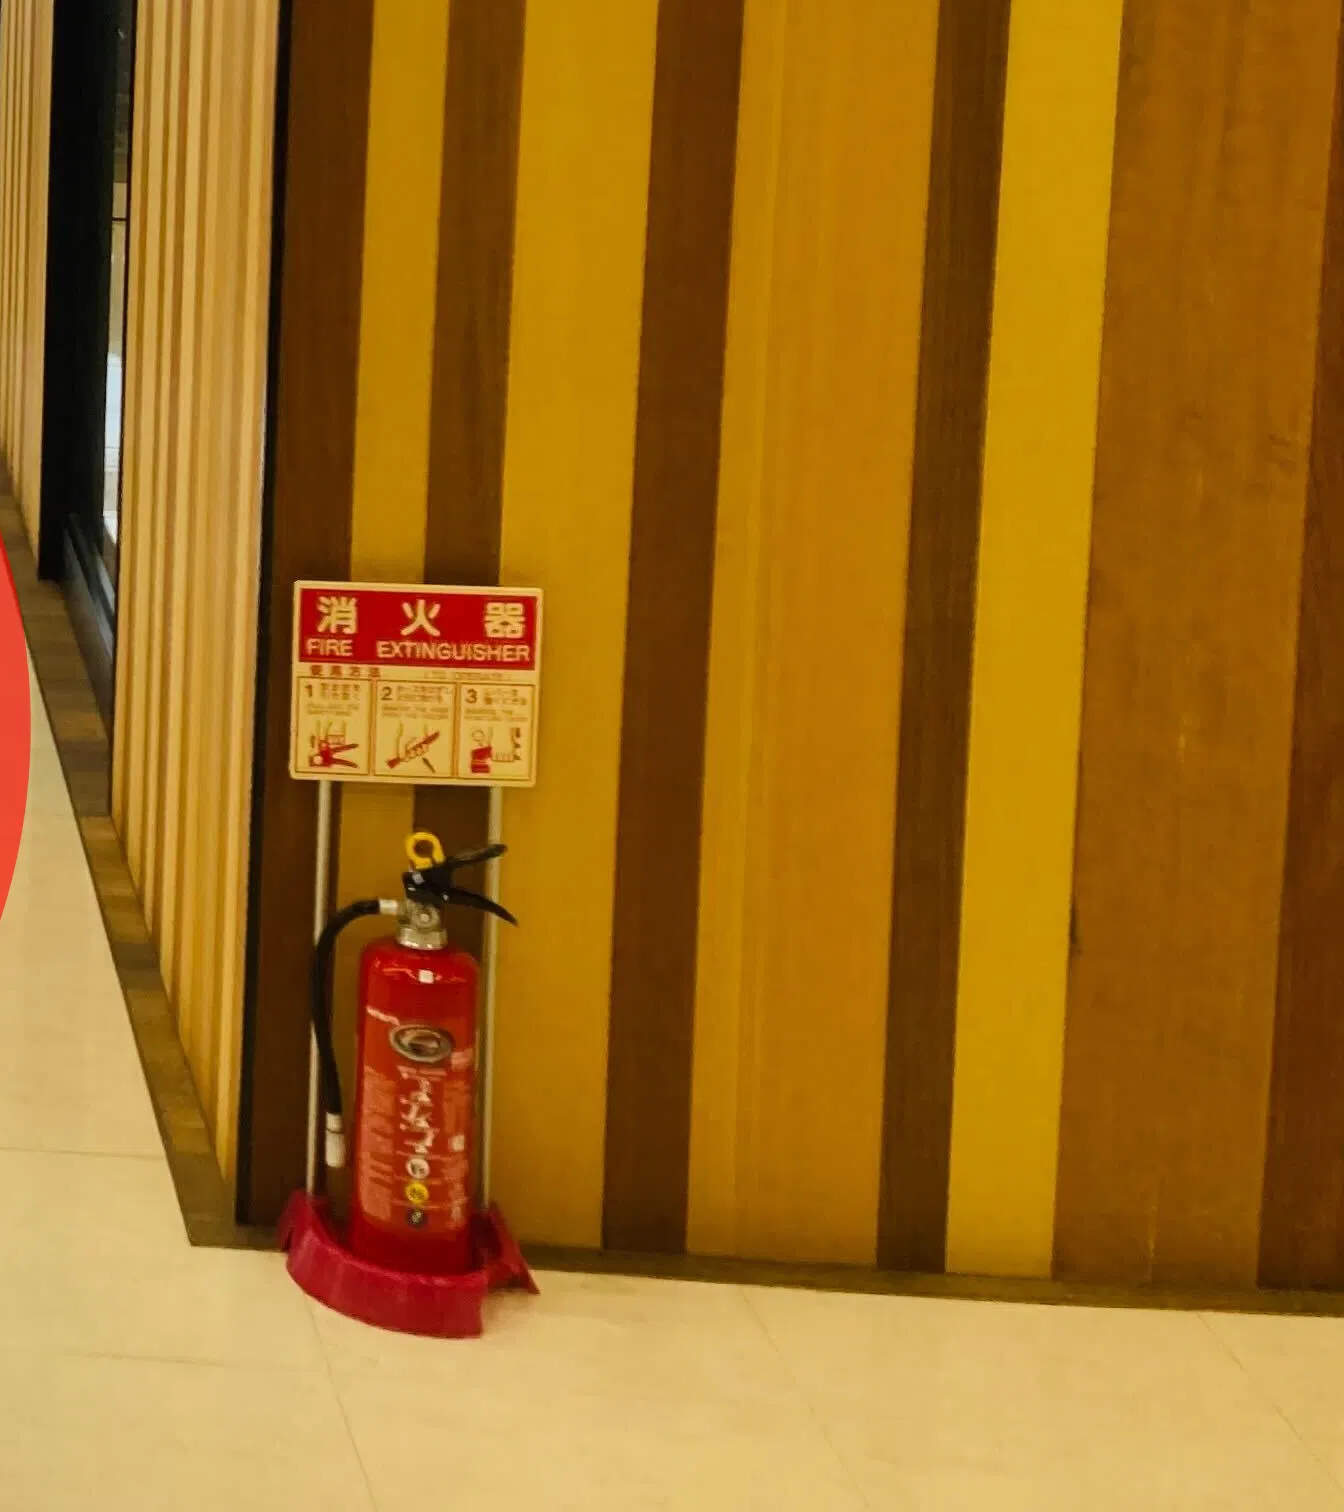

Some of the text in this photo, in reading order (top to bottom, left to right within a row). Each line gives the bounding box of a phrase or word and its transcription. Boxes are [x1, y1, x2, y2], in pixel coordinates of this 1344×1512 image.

[316, 595, 526, 639] 消火器
[306, 638, 530, 662] FIRE EXTINGUISHER
[381, 687, 393, 701] 2
[466, 689, 478, 704] 3
